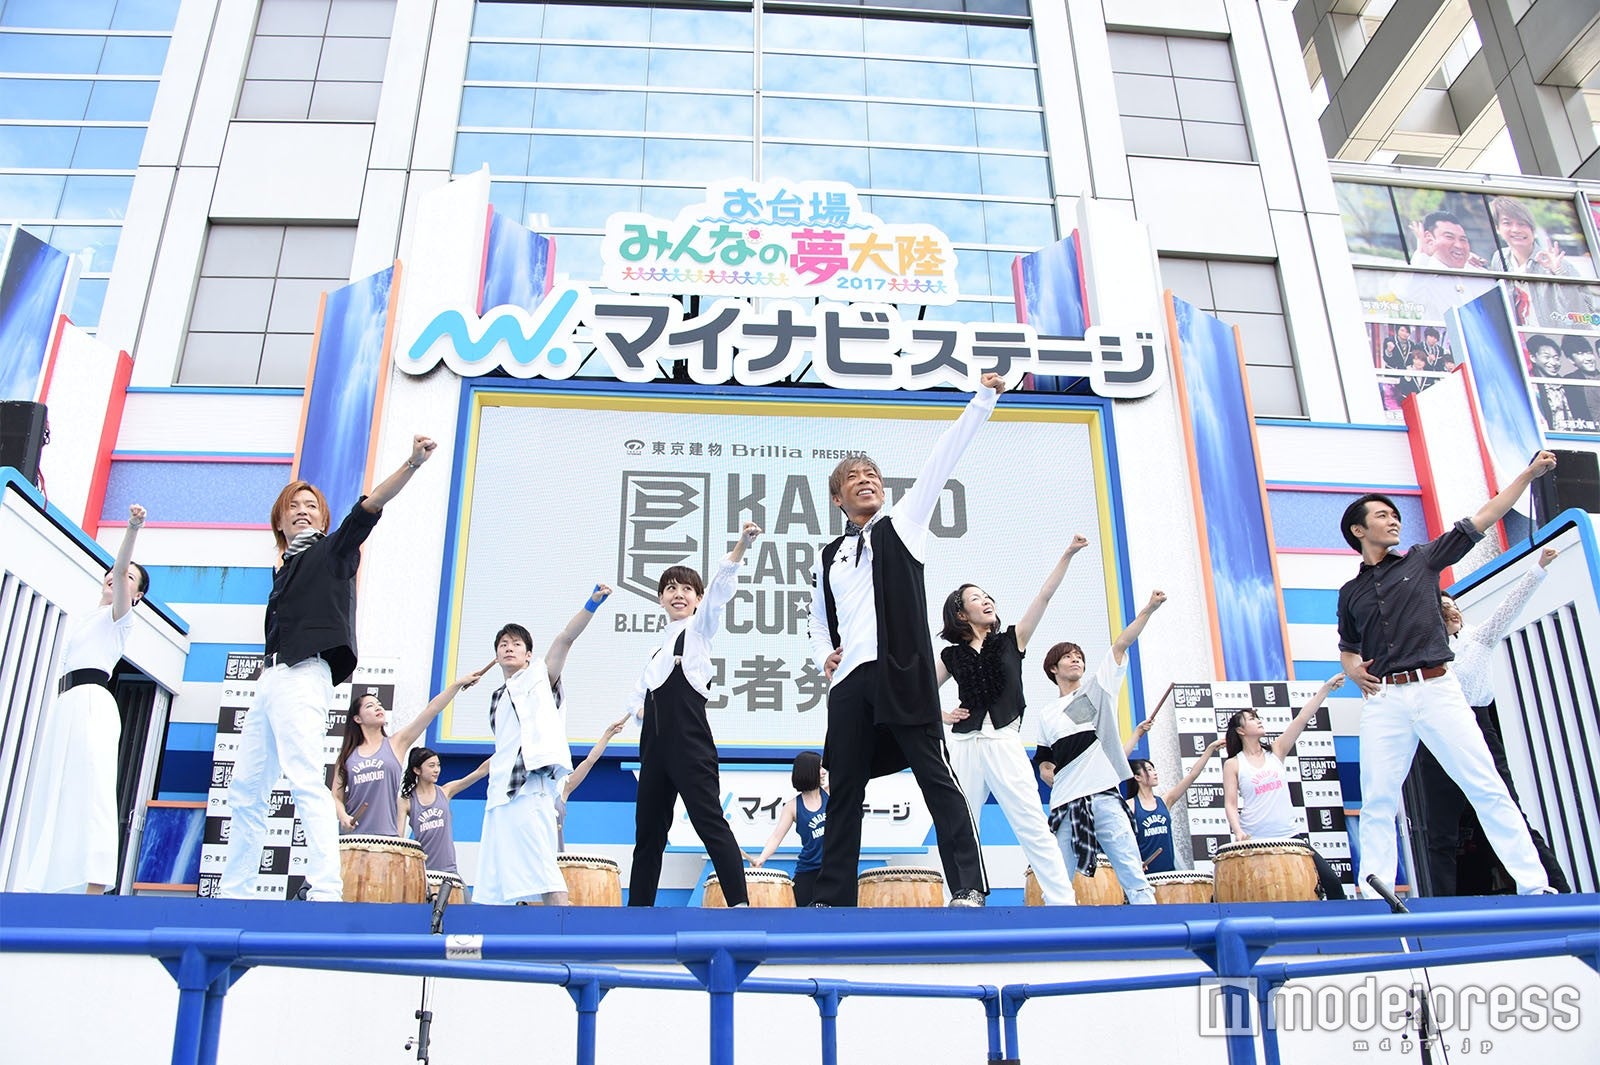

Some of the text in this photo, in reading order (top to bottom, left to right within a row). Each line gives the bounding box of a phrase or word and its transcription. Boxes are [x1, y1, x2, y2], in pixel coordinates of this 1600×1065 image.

[722, 188, 851, 223] お台場
[618, 224, 947, 286] みんなの夢大陸
[837, 276, 886, 291] 2017
[594, 304, 1156, 383] マイナビステージ
[651, 440, 723, 457] 東京建物
[731, 443, 803, 459] Brillia
[351, 759, 384, 774] UNDER
[353, 770, 385, 786] ARMOUR
[417, 808, 444, 823] UNDER
[1141, 814, 1167, 829] UNDER
